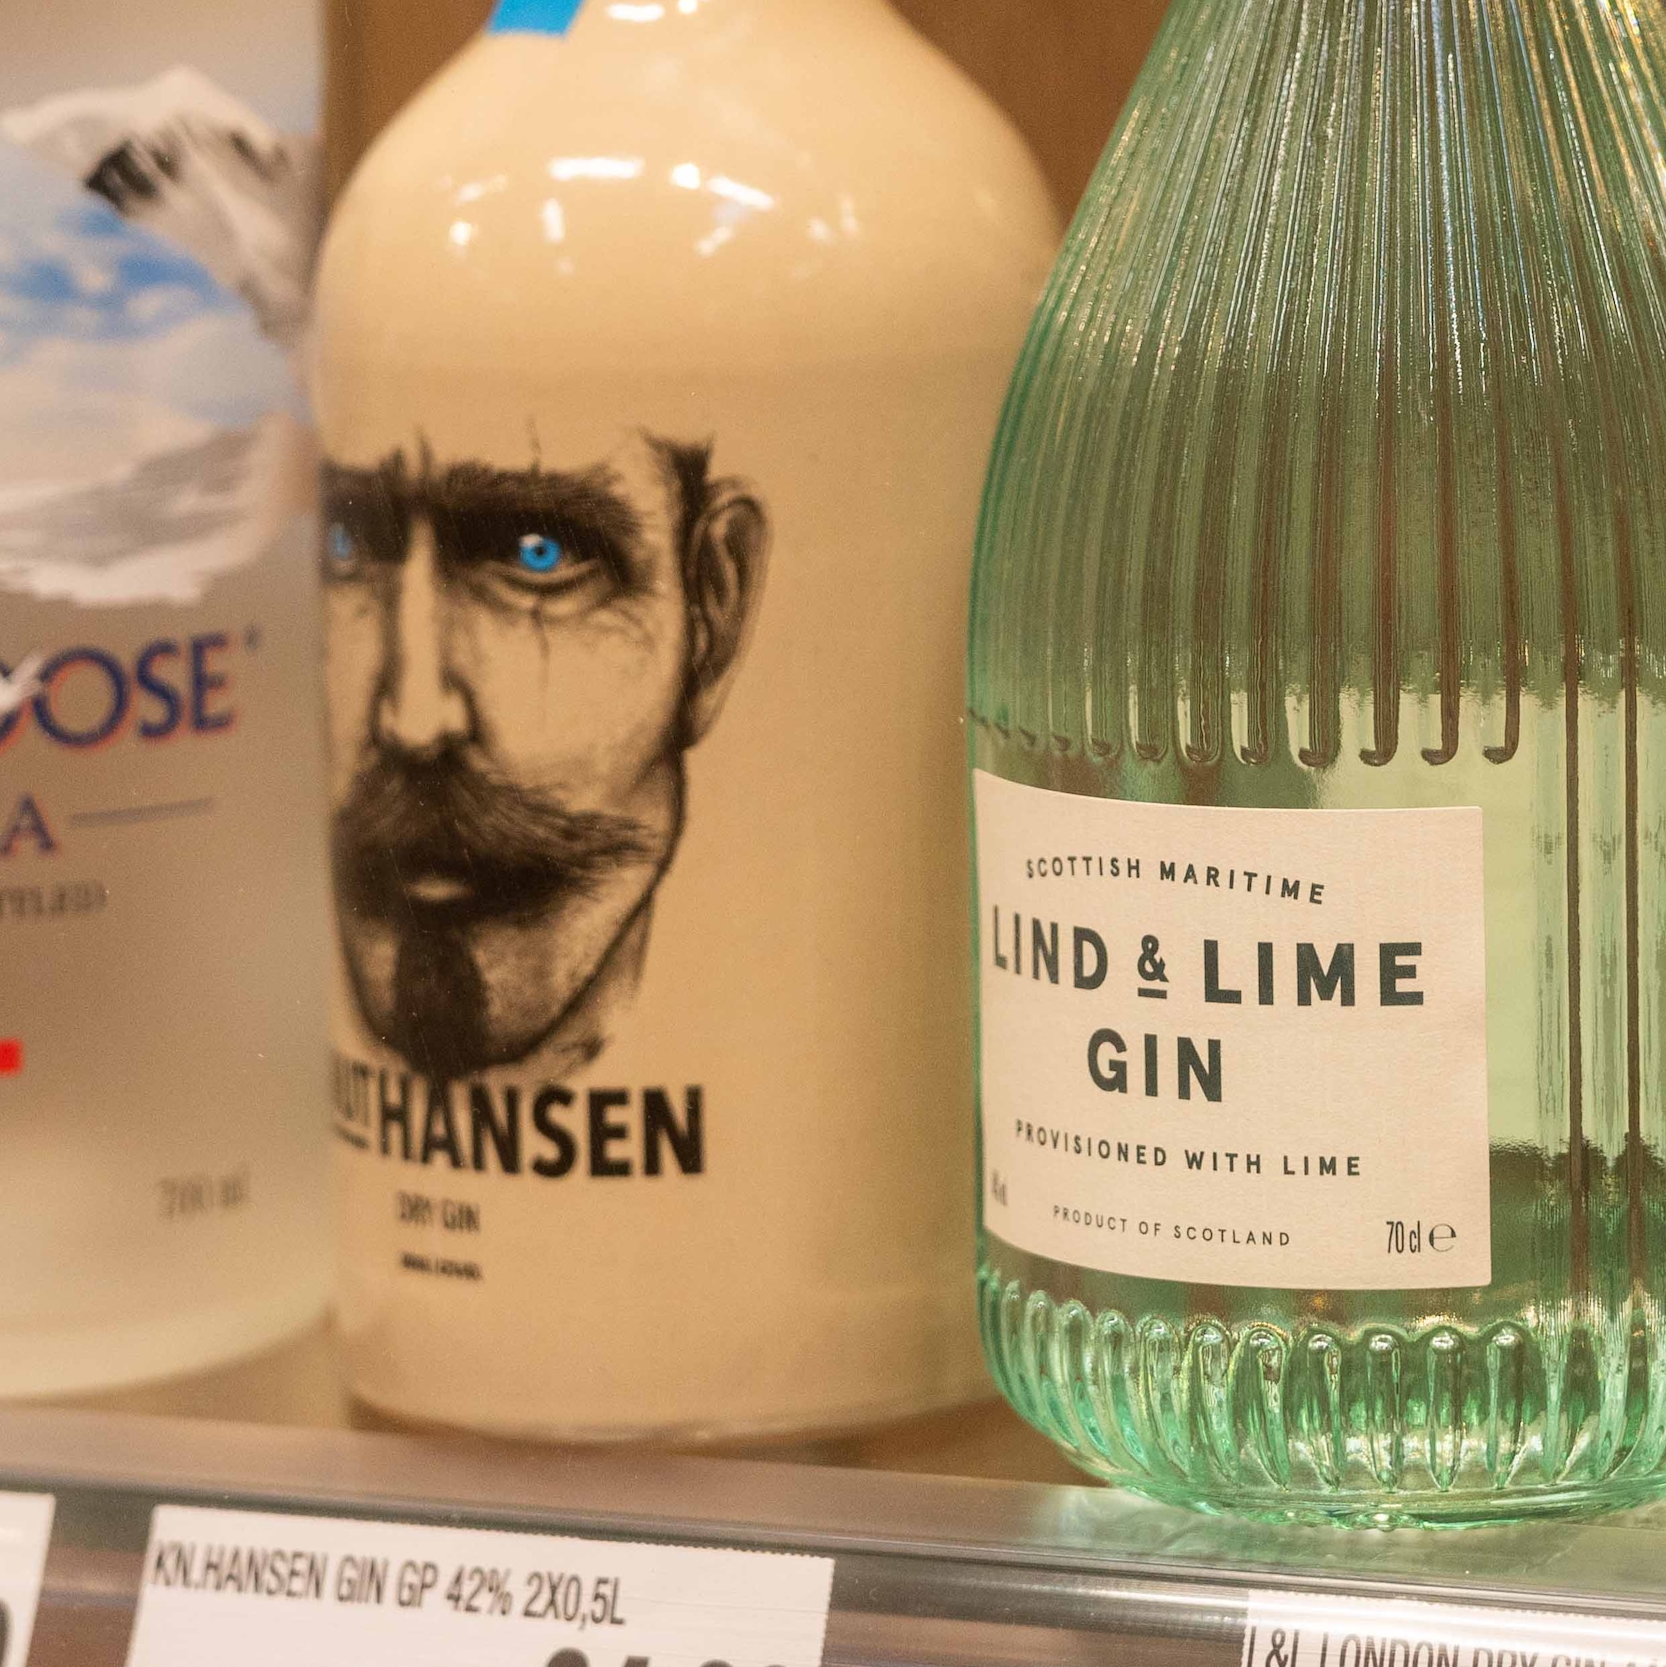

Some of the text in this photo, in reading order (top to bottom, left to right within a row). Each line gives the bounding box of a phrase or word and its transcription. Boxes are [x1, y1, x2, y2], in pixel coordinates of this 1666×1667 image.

[1026, 856, 1325, 905] SCOTTISH MARITIME
[992, 904, 1424, 1006] LIND & LIME
[1087, 1027, 1223, 1103] GIN
[379, 1068, 705, 1179] HANSEN
[1015, 1118, 1361, 1177] PROVISIONED WITH LIME
[441, 1198, 481, 1233] GIN
[1052, 1204, 1290, 1247] PRODUCT OF SCOTLAND
[150, 1540, 627, 1630] KN.HANSEN GIN GP 42% 2X0,5L
